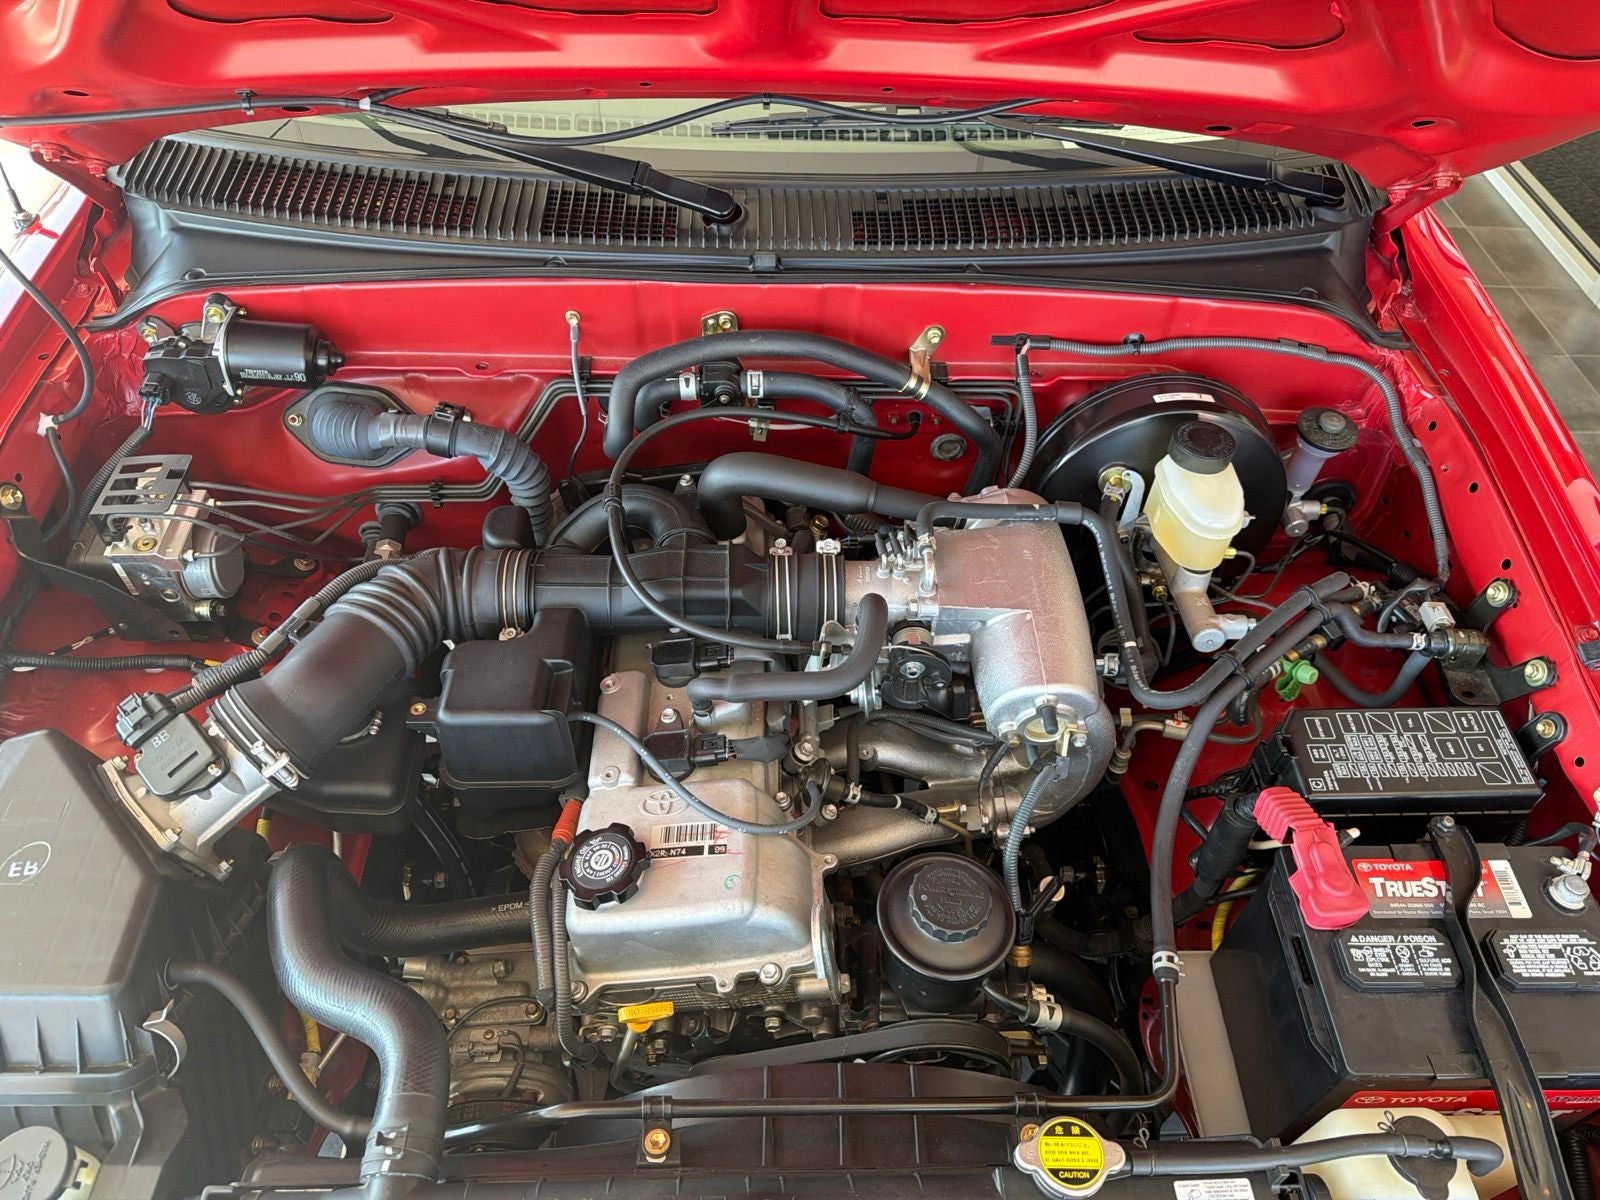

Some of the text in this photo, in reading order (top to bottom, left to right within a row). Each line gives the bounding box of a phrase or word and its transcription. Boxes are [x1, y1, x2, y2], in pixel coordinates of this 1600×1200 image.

[293, 372, 307, 382] 90
[151, 730, 170, 748] BB
[1312, 781, 1323, 789] C
[574, 845, 590, 878] ENGINE OIL
[1373, 863, 1413, 871] TOYOTA
[1390, 1096, 1467, 1104] TOYOTA
[1059, 1171, 1090, 1179] CAUTION
